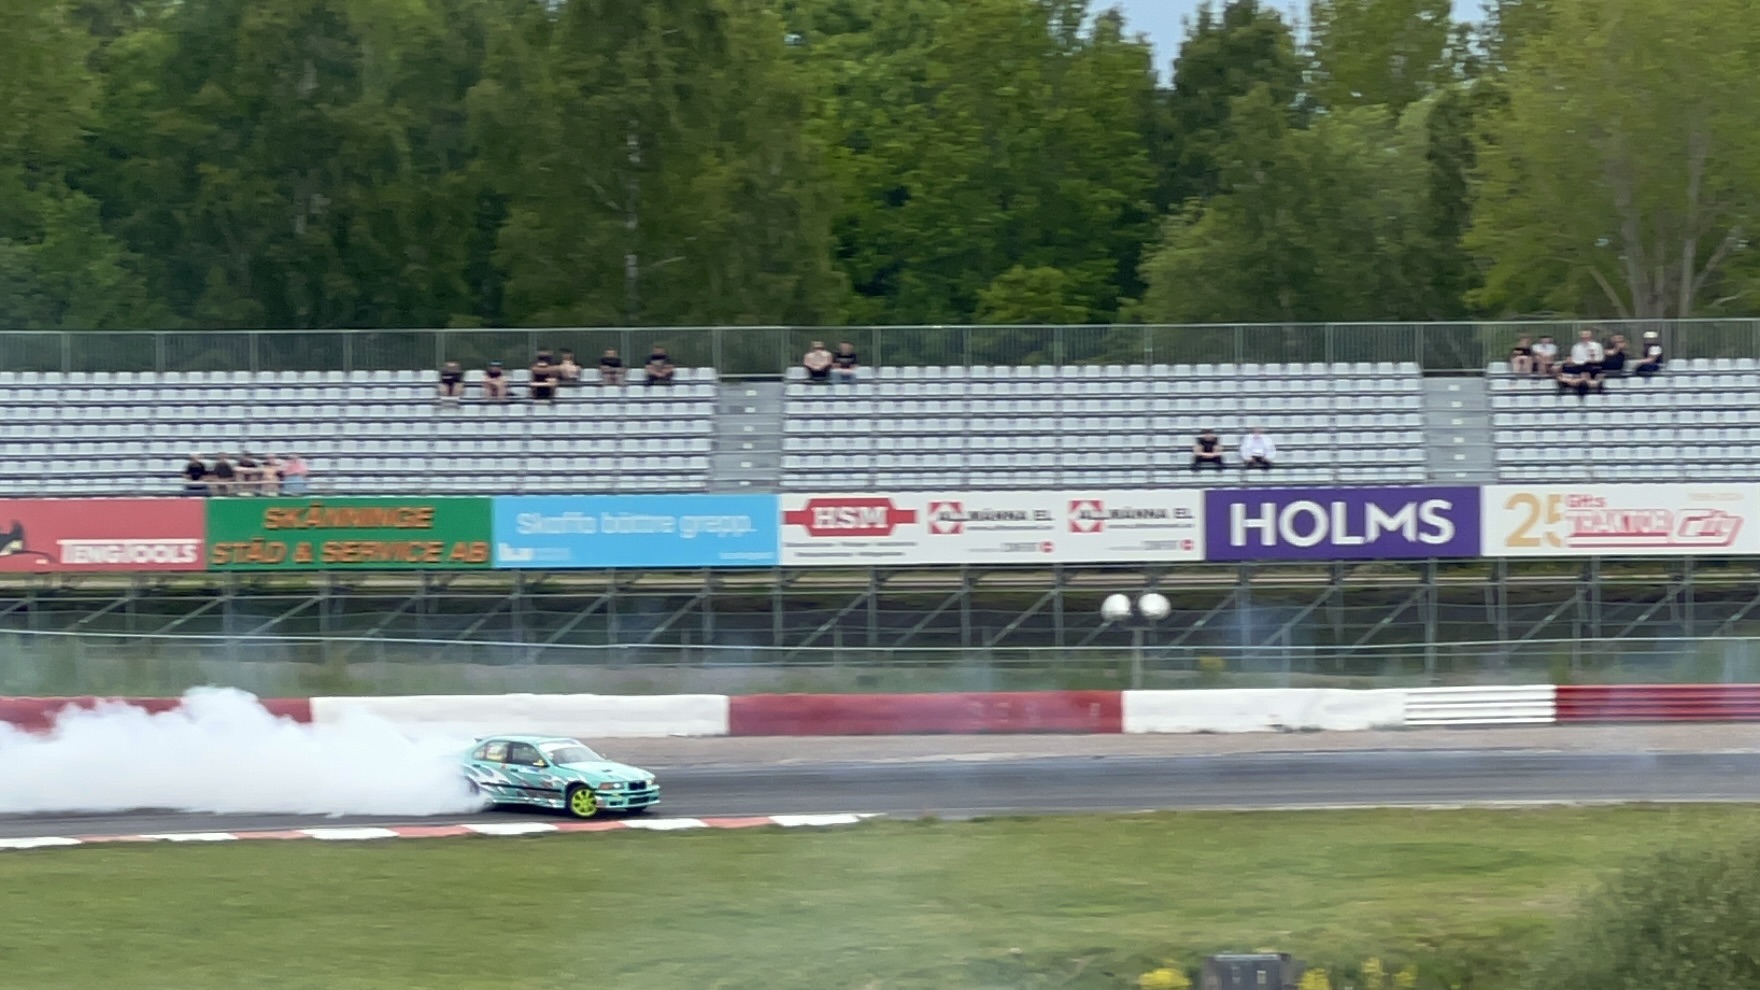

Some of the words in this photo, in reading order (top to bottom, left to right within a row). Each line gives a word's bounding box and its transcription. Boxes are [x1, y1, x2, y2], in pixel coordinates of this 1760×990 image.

[812, 506, 889, 529] HSM
[1229, 499, 1456, 547] HOLMS
[293, 541, 313, 563] &
[321, 540, 444, 564] SERVICE
[450, 540, 489, 564] AB
